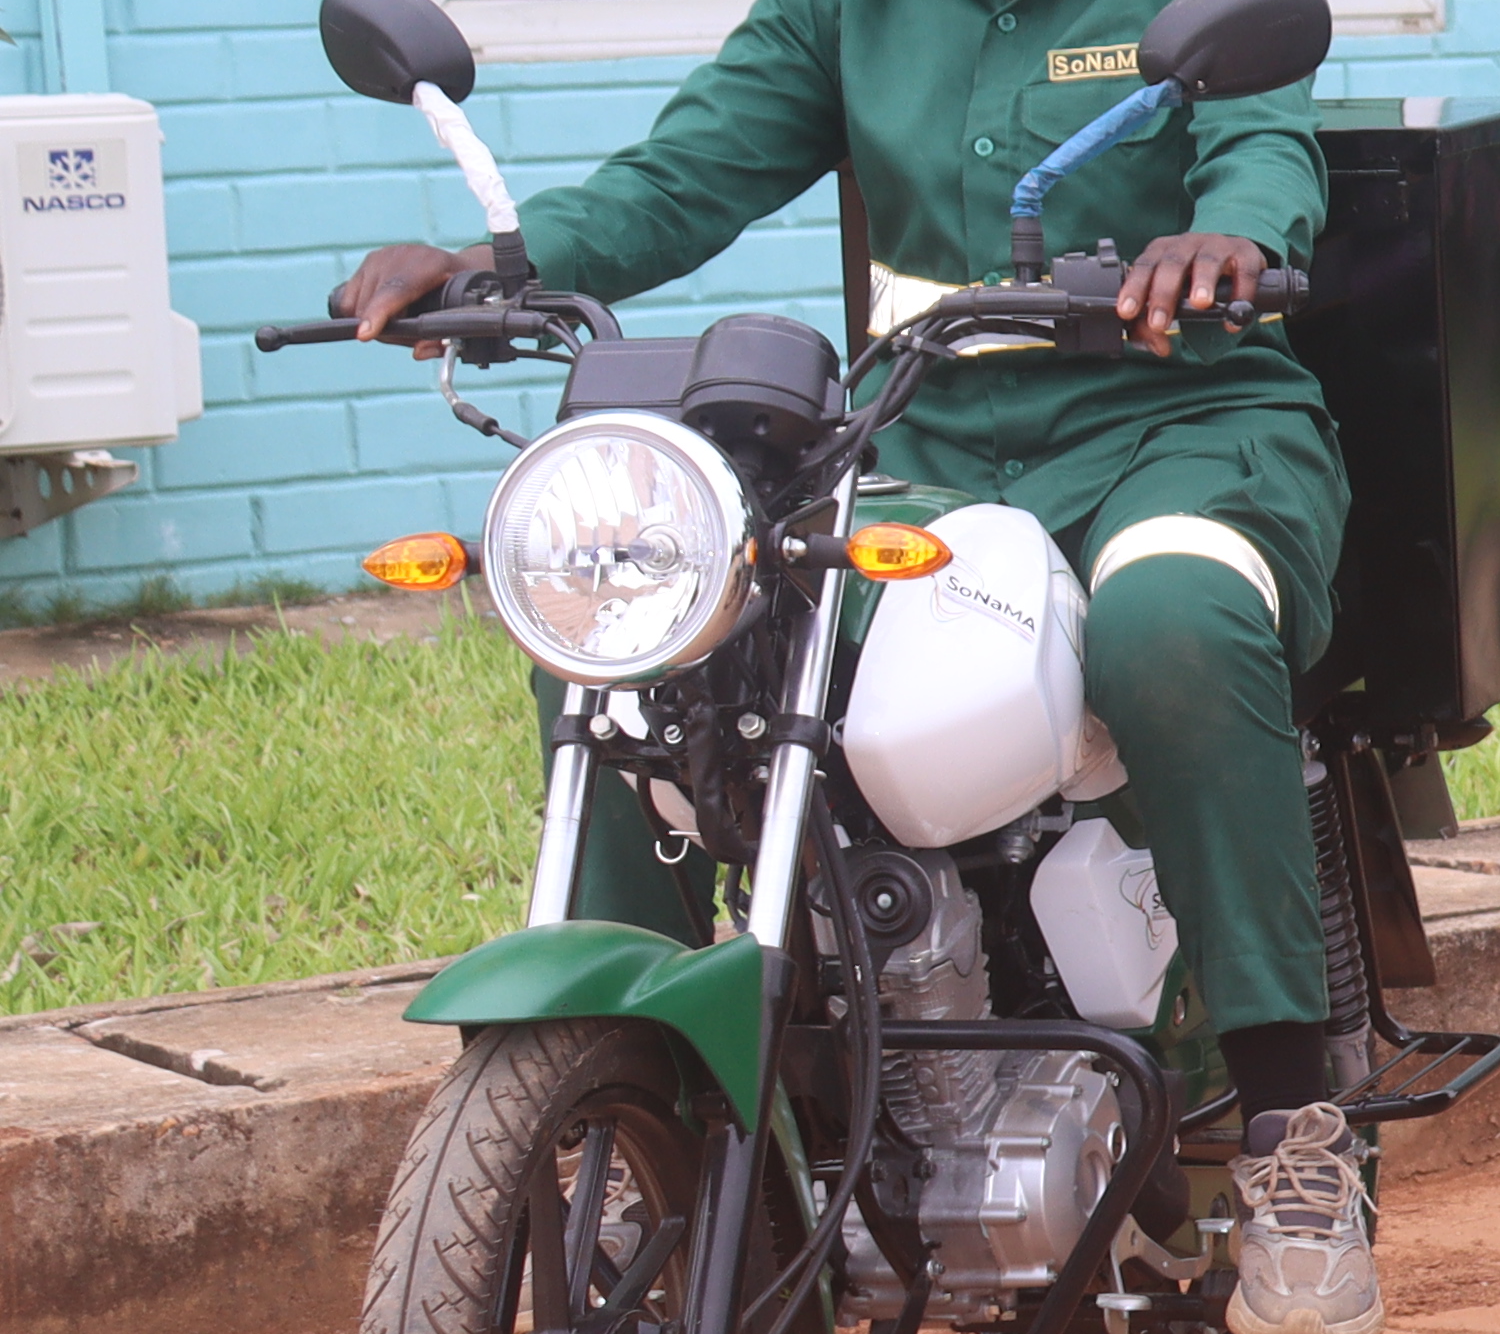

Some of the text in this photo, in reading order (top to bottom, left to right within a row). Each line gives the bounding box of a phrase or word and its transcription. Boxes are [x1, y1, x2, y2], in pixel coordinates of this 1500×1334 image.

[1054, 49, 1138, 75] SoNaM
[23, 193, 126, 213] NASCO
[946, 575, 1036, 633] SoNaMA
